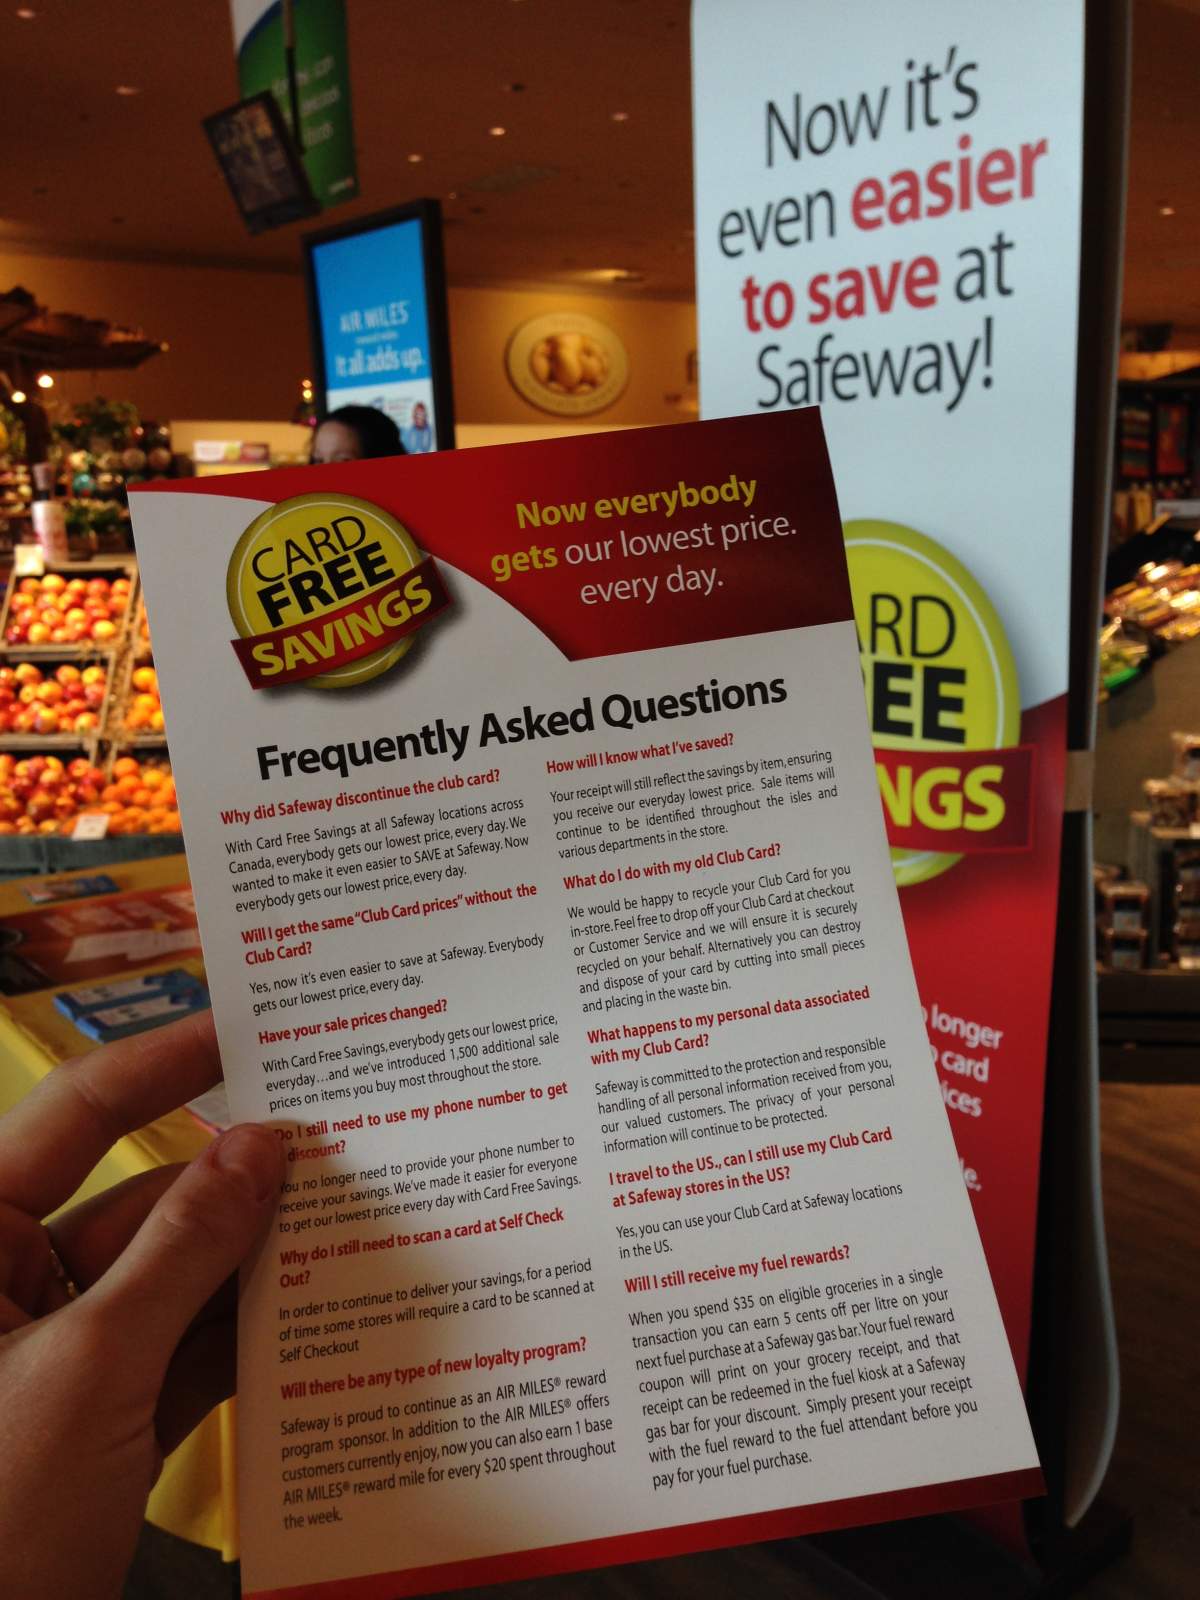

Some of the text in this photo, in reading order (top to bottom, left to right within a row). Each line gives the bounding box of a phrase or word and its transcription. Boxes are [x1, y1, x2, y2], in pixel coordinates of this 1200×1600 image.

[765, 45, 979, 168] Now it's
[718, 135, 1049, 258] even easier
[742, 232, 1015, 333] to save at
[340, 310, 362, 333] AIR
[348, 349, 365, 376] all
[366, 346, 399, 373] adds
[756, 316, 994, 413] Safeway!
[515, 475, 757, 530] Now everybody
[251, 514, 367, 582] CARD
[491, 511, 798, 582] gets our lowest price.
[255, 543, 396, 627] FREE
[580, 565, 724, 606] every day.
[251, 576, 432, 677] SAVINGS
[857, 593, 957, 659] RD
[257, 678, 787, 780] Frequently Asked Questions
[864, 664, 966, 743] EE
[546, 732, 734, 774] How will I know what I've saved?
[549, 750, 832, 803] Your receipt will still reflect the savings by item, ensuring
[220, 768, 500, 825] Why did Safeway discontinue the club card?
[225, 799, 524, 855] With Card Free Savings at all Safeway locations across
[563, 843, 781, 890] What do I do with my old Club Card?
[240, 927, 267, 944] Will
[268, 926, 273, 940] I
[274, 924, 297, 942] get
[297, 920, 320, 934] the
[321, 916, 355, 930] same
[391, 901, 421, 918] Card
[464, 888, 513, 906] without
[516, 883, 537, 898] the
[245, 941, 312, 965] Club Card?
[258, 999, 447, 1045] Have your sale prices changed?
[587, 985, 870, 1044] What happens to my personal data associated
[931, 1004, 1003, 1049] longer
[590, 1033, 709, 1065] with my Club Card?
[595, 1037, 886, 1095] Safeway is committed to the protection and responsible
[941, 1050, 989, 1083] card
[939, 1080, 983, 1118] ices
[624, 1244, 850, 1293] Will I still receive my fuel rewards?
[628, 1266, 943, 1326] When you spend $35 on eligible groceries in a single
[280, 1336, 586, 1400] Will there be any type of new loyalty program?
[282, 1461, 345, 1482] customers
[347, 1449, 402, 1471] currently
[469, 1438, 492, 1456] you
[495, 1434, 517, 1448] can
[519, 1428, 543, 1444] also
[545, 1425, 572, 1439] earn
[576, 1421, 581, 1434] 1
[584, 1418, 613, 1433] base
